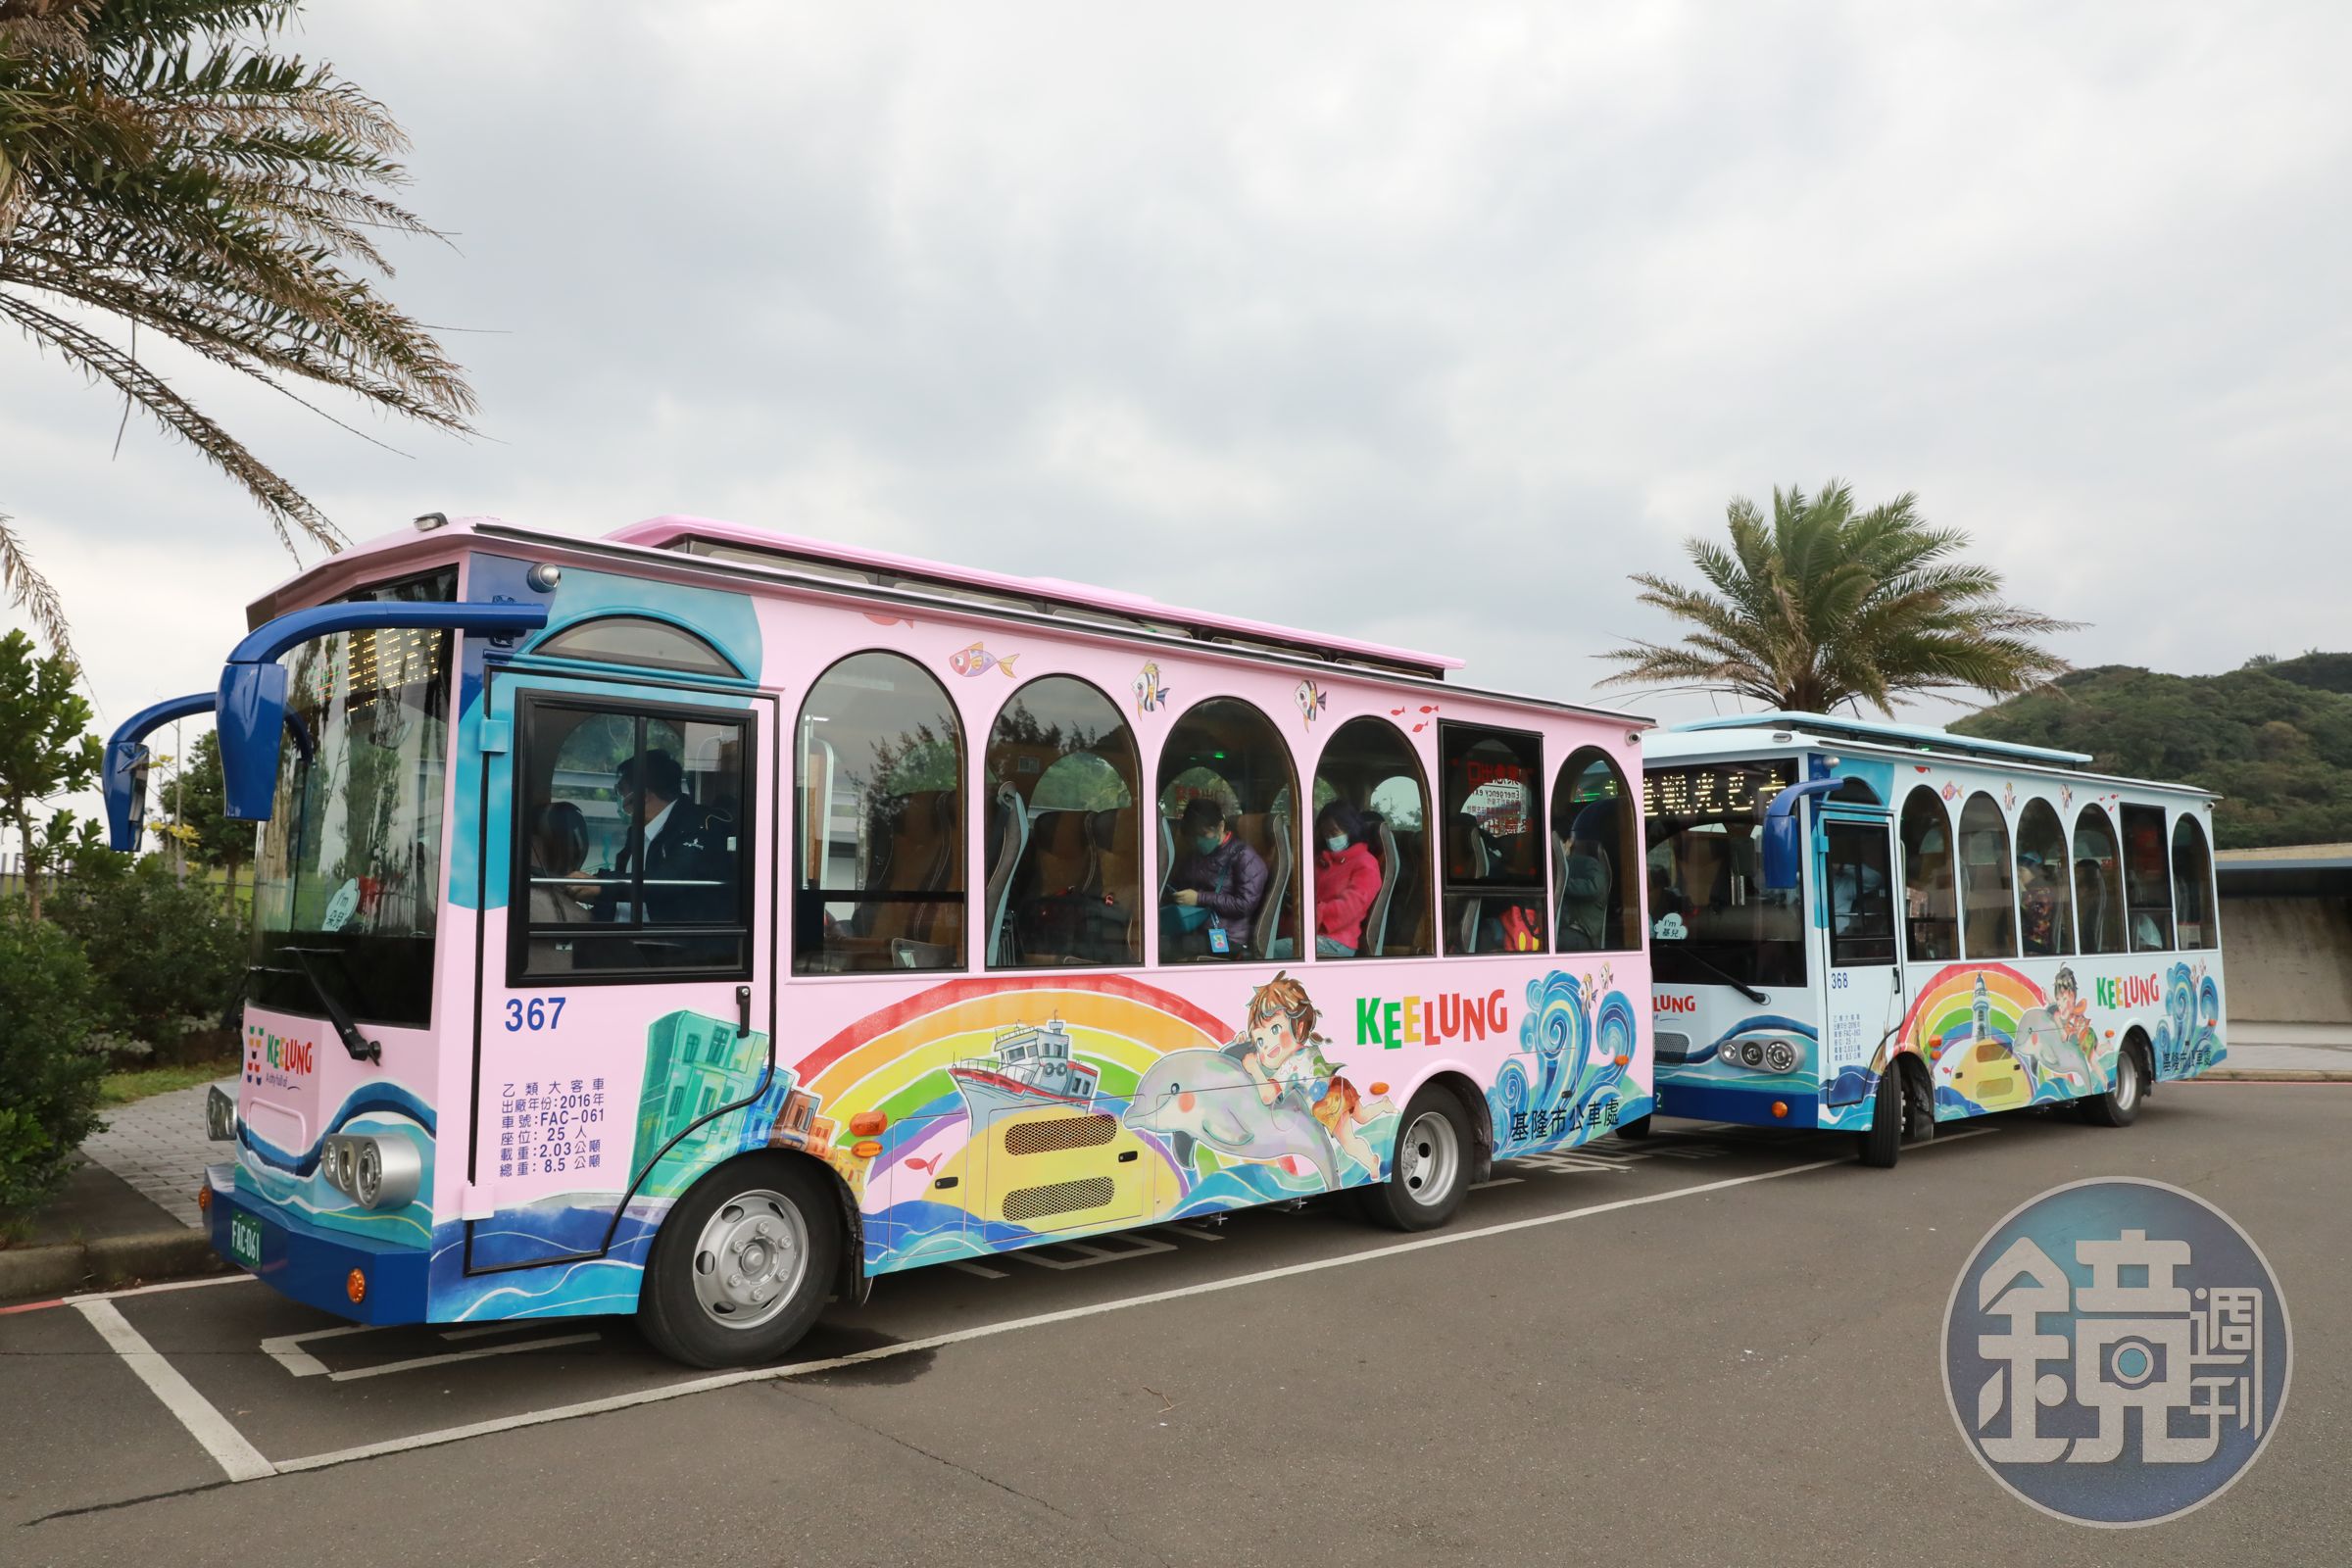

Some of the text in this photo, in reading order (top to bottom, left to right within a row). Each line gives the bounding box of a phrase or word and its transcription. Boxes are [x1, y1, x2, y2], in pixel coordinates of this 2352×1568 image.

[1832, 972, 1848, 989] 368
[2096, 973, 2160, 1009] KEELUNG
[505, 998, 566, 1031] 367
[1356, 989, 1507, 1050] KEELUNG
[1652, 994, 1695, 1013] LUNG
[267, 1034, 313, 1075] KEELUNG
[502, 1078, 605, 1098] 乙類大客車
[1512, 1099, 1619, 1142] 基隆市公車處
[231, 1220, 260, 1262] FAC-061
